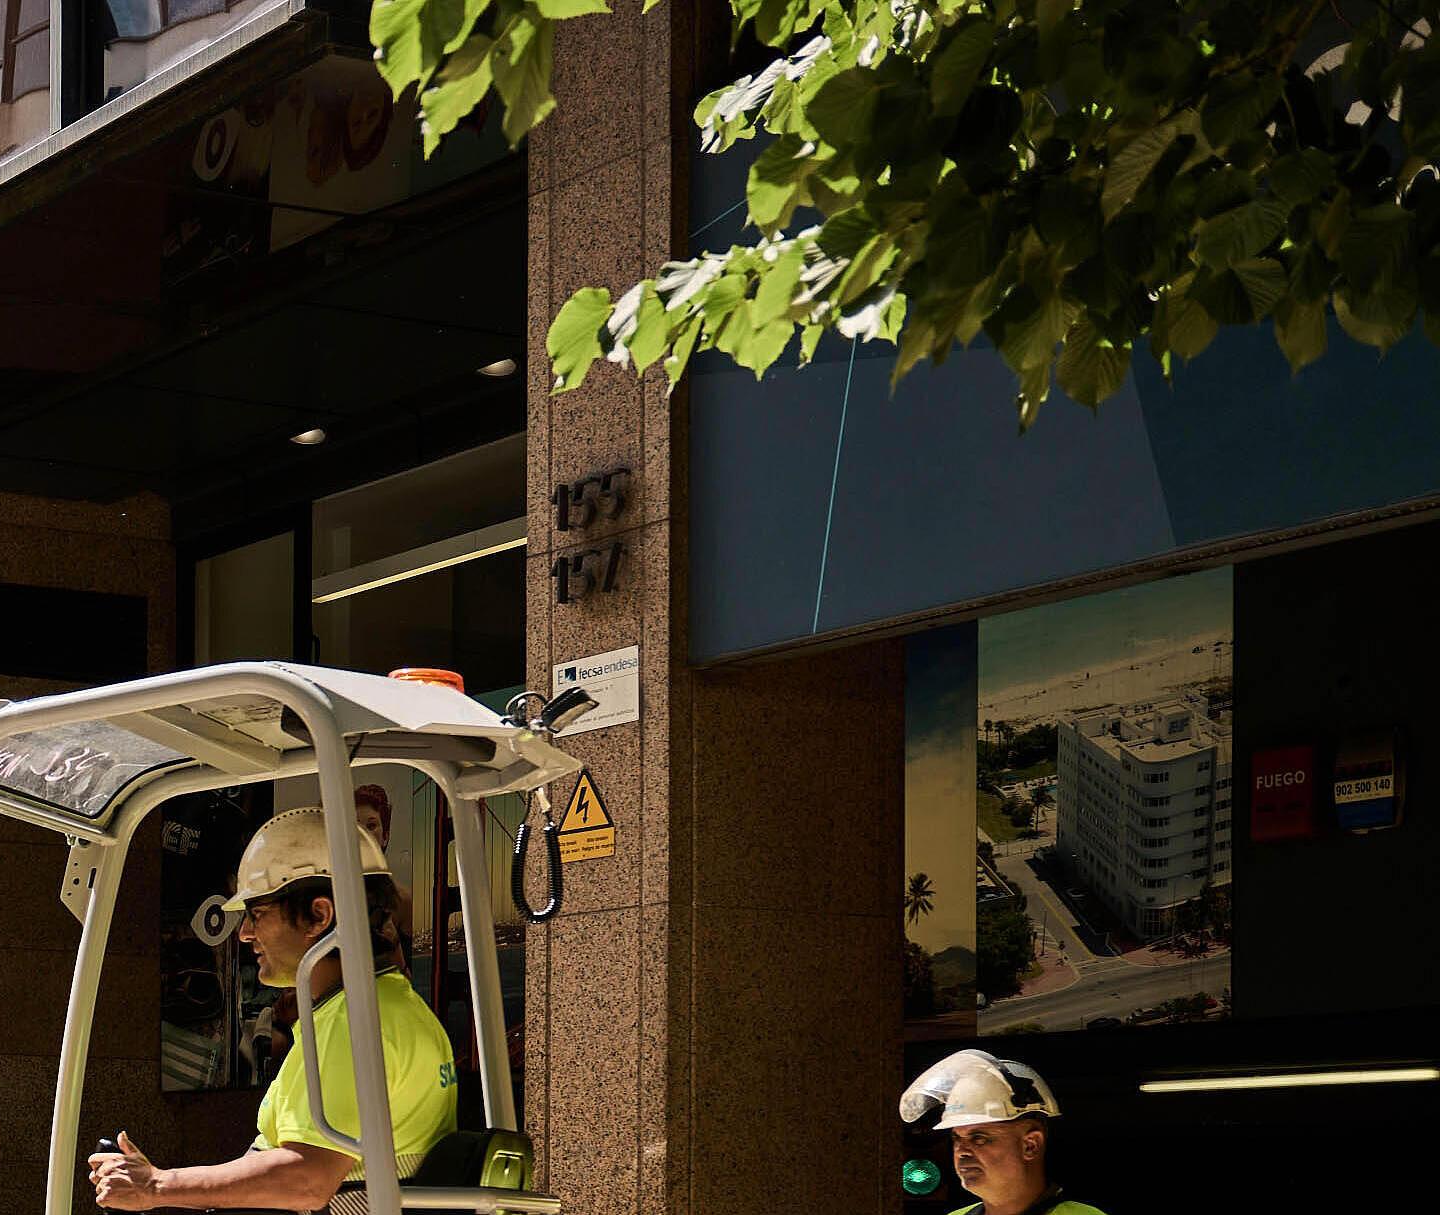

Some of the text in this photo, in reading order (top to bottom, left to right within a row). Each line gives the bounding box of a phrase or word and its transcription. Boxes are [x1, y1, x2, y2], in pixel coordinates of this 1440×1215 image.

[578, 666, 603, 681] fecsa
[603, 657, 638, 675] endesa
[1256, 770, 1306, 790] FUEGO
[1335, 778, 1390, 797] 902 500 140
